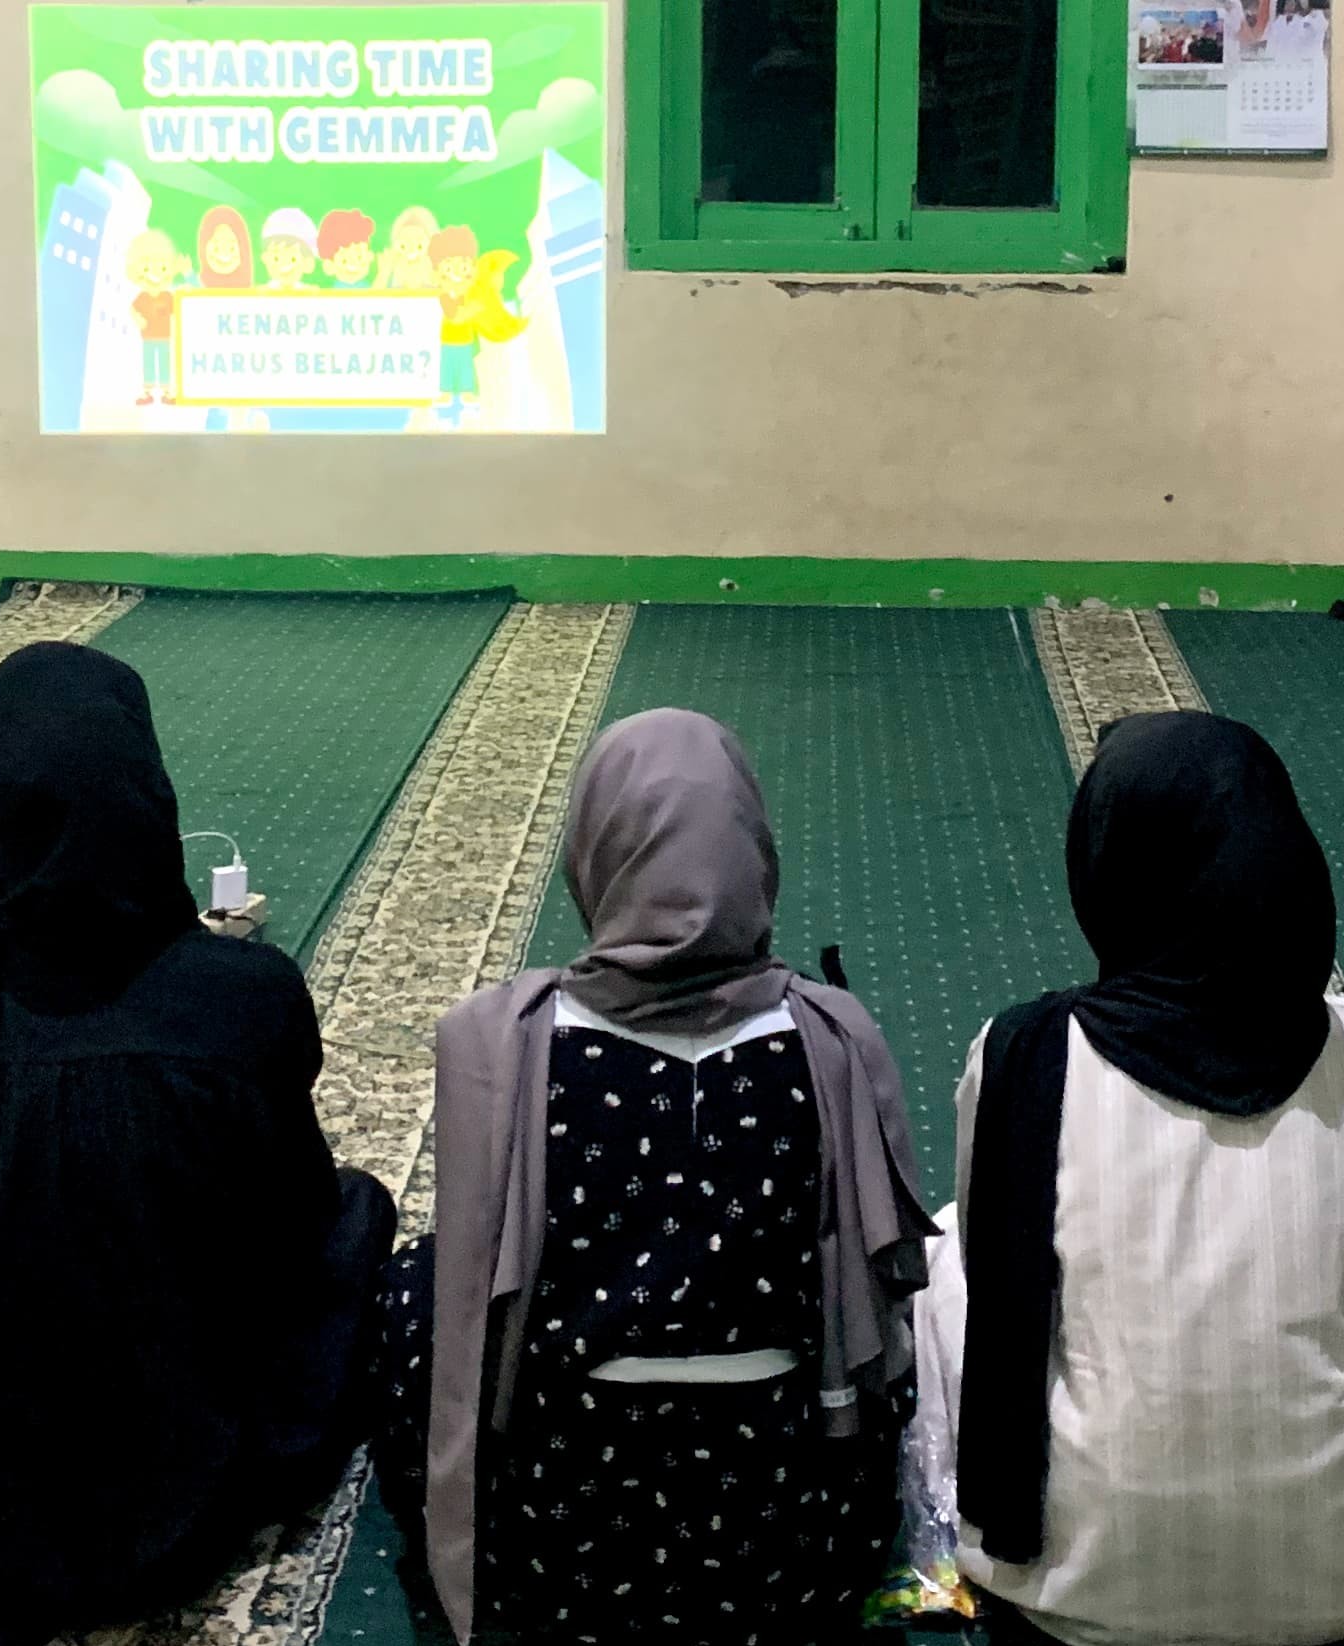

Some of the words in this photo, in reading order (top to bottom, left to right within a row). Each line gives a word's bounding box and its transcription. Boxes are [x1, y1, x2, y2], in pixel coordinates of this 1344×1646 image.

[149, 48, 353, 89] SHARING
[371, 47, 487, 88] TIME
[147, 115, 267, 154] WITH
[285, 115, 491, 154] GEMMFA
[216, 313, 329, 336] KENAPA
[341, 313, 405, 336] KITA
[190, 352, 284, 375] HARUS
[294, 349, 432, 379] BELAJAR?
